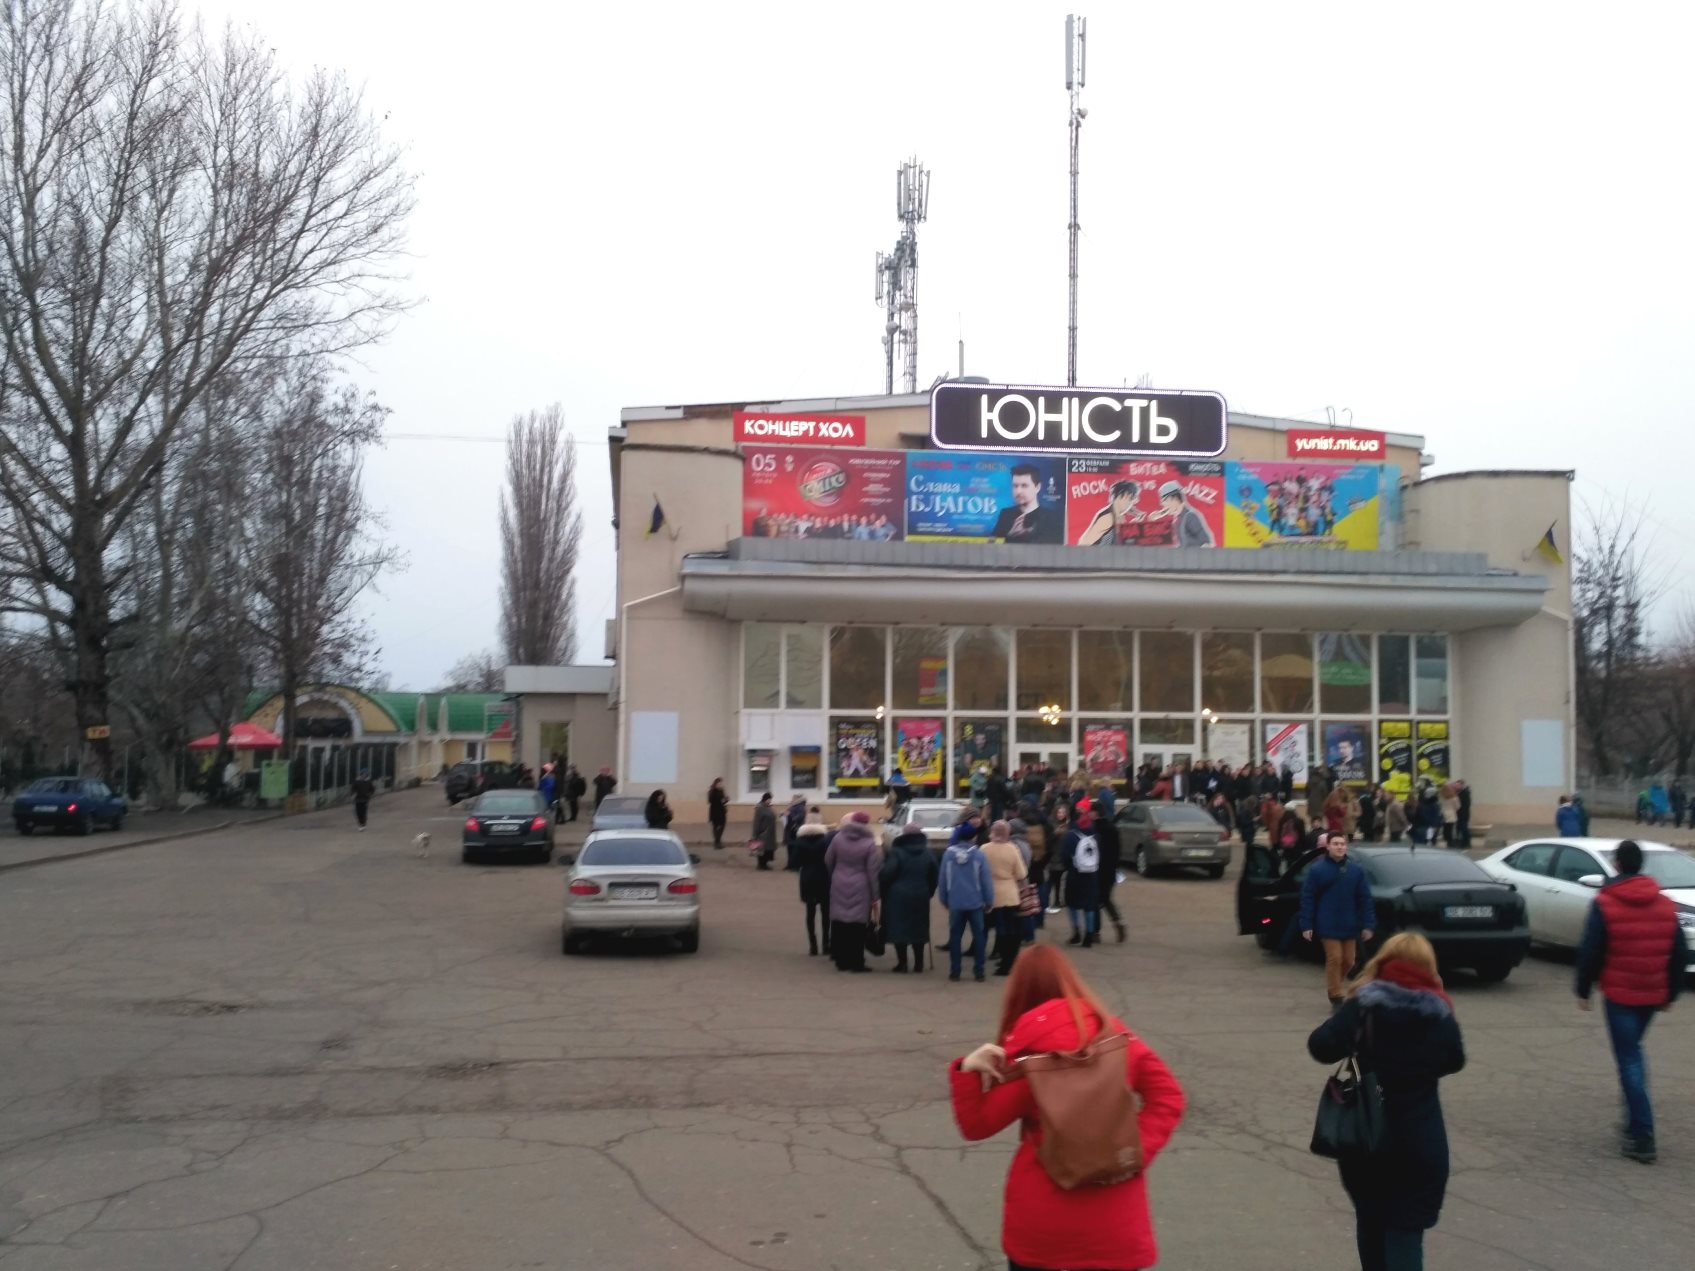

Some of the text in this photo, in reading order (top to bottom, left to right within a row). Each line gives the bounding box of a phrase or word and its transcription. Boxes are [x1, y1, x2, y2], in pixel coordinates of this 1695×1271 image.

[981, 394, 1178, 443] ЮНІСТЬ
[744, 419, 854, 438] КОНЦЕРТ ХОЛ
[1295, 436, 1379, 451] yunist.mk.ua
[752, 453, 776, 471] 05
[1071, 459, 1086, 472] 23
[1129, 462, 1167, 476] БИТВА
[910, 475, 960, 493] Слава
[1072, 479, 1108, 498] ROCK
[1182, 480, 1218, 504] JAZZ
[910, 494, 997, 517] БЛАГОВ
